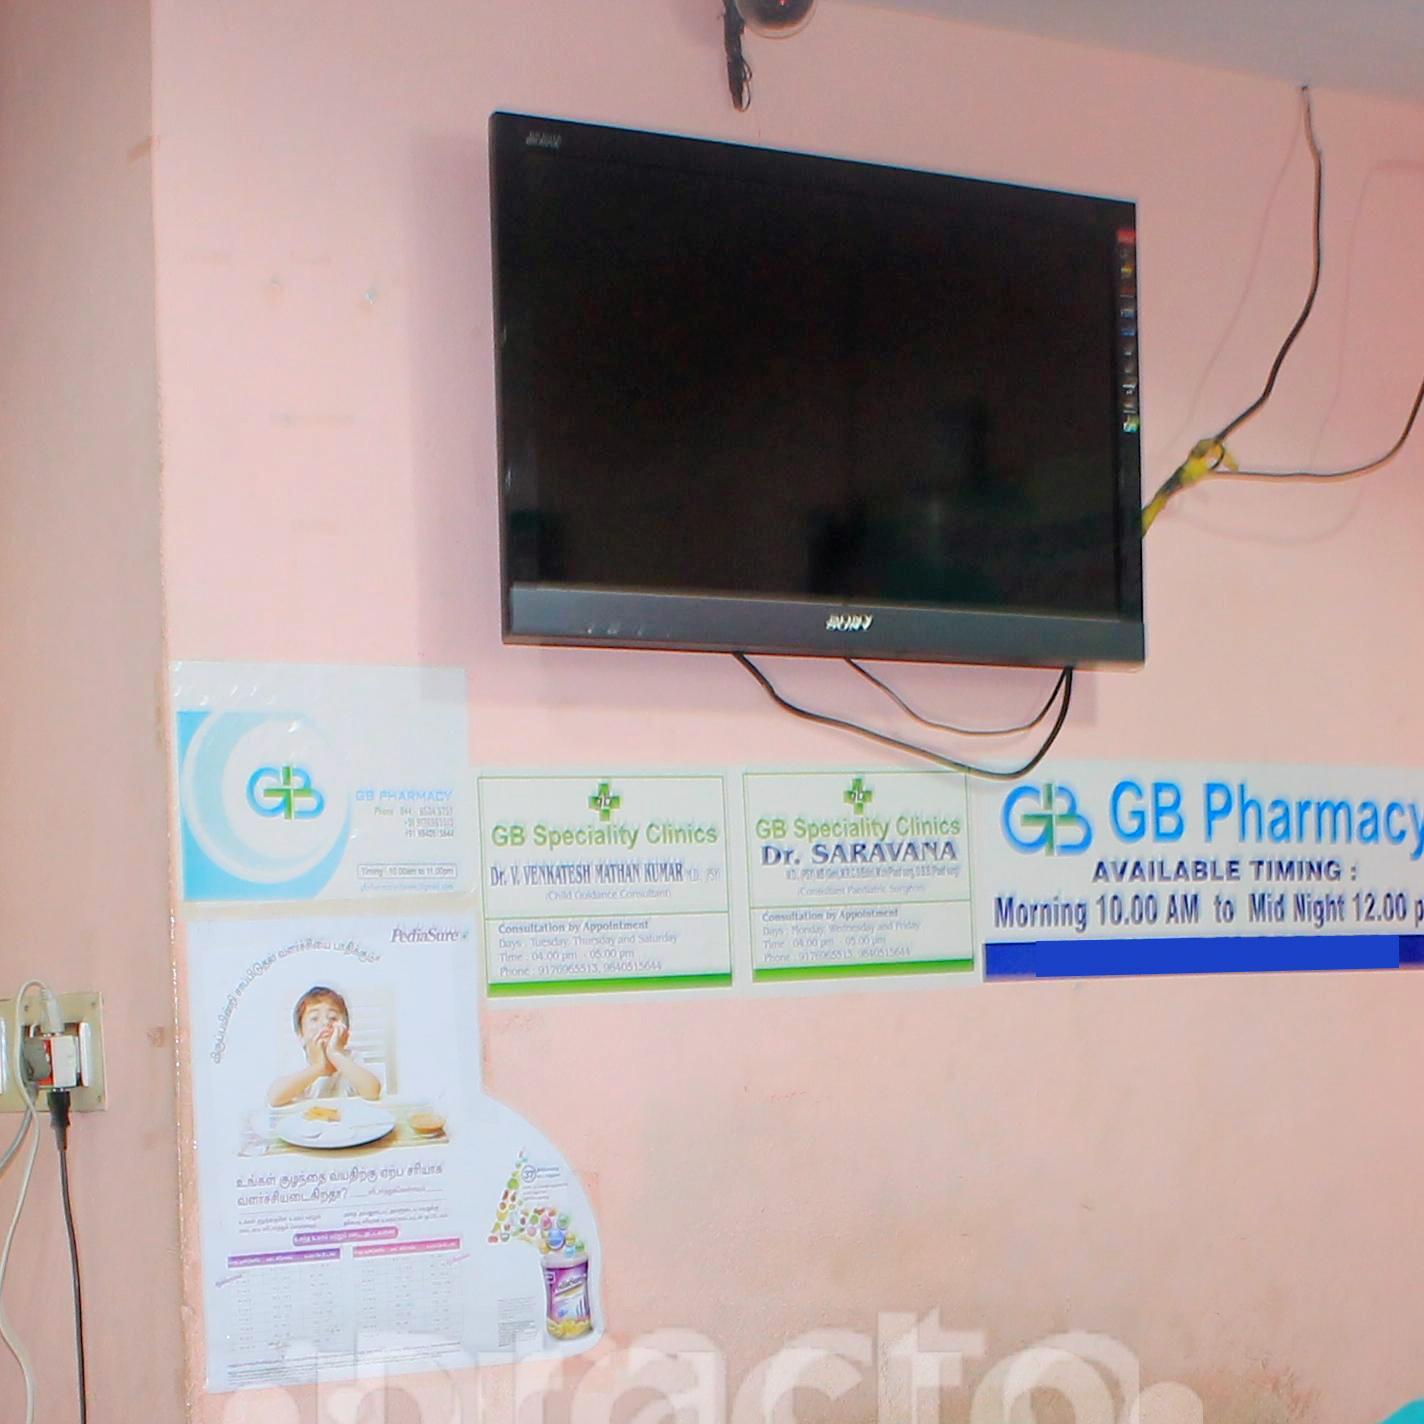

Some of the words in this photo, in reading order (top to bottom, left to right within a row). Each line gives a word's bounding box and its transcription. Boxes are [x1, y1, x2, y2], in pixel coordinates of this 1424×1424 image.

[379, 788, 453, 801] PHARMACY
[1110, 780, 1185, 844] GB
[491, 825, 526, 847] GB
[533, 824, 639, 850] Speciality
[645, 822, 718, 845] Clinics
[755, 819, 787, 839] GB
[793, 818, 890, 842] Speciality
[895, 816, 961, 836] Clinics
[760, 845, 801, 866] Dr.
[811, 840, 958, 864] SARAVANA
[490, 865, 508, 887] Dr.
[510, 865, 521, 886] V.
[523, 863, 591, 886] VENKATESH
[594, 862, 641, 884] MATHAN
[644, 861, 684, 883] KUMAR
[1092, 861, 1241, 883] AVAILABLE
[1250, 860, 1343, 881] TIMING
[762, 910, 823, 922] Consultation
[826, 910, 837, 920] by
[838, 908, 899, 920] Appointment
[994, 896, 1088, 933] Morning
[1095, 894, 1158, 926] 10.00
[1166, 894, 1200, 925] AM
[1214, 895, 1236, 924] to
[1248, 892, 1285, 923] Mid
[1293, 891, 1346, 928] Night
[1352, 892, 1407, 923] 12.00
[391, 927, 459, 944] PediaSure
[498, 923, 565, 935] Consultation
[568, 922, 581, 934] by
[583, 920, 649, 933] Appointment
[573, 934, 617, 947] Thursday
[618, 935, 636, 944] and
[638, 932, 678, 944] Saturday
[500, 952, 522, 962] Time
[561, 952, 576, 962] pm
[618, 950, 635, 960] pm
[500, 966, 530, 976] Phone
